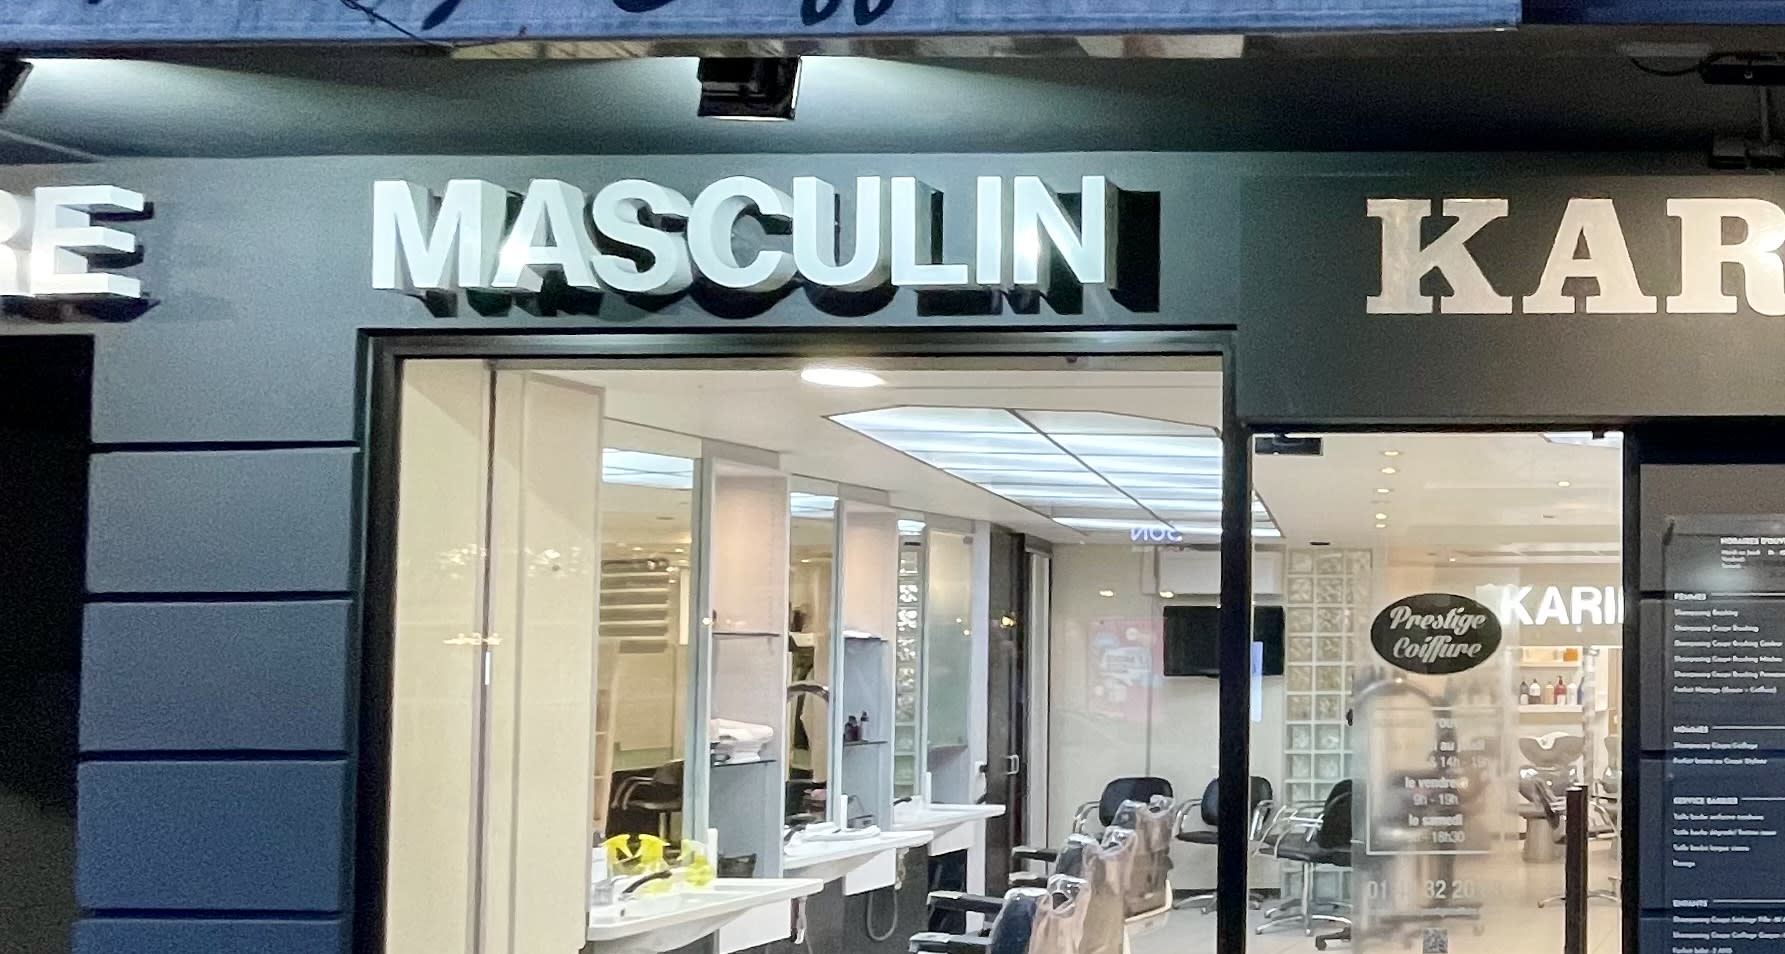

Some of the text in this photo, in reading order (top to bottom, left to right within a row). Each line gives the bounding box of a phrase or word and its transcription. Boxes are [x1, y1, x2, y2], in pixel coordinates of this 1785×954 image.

[371, 175, 1107, 293] MASCULIN
[1389, 605, 1487, 636] Prestige
[1500, 585, 1624, 625] KARI
[1393, 635, 1482, 663] Coiffure
